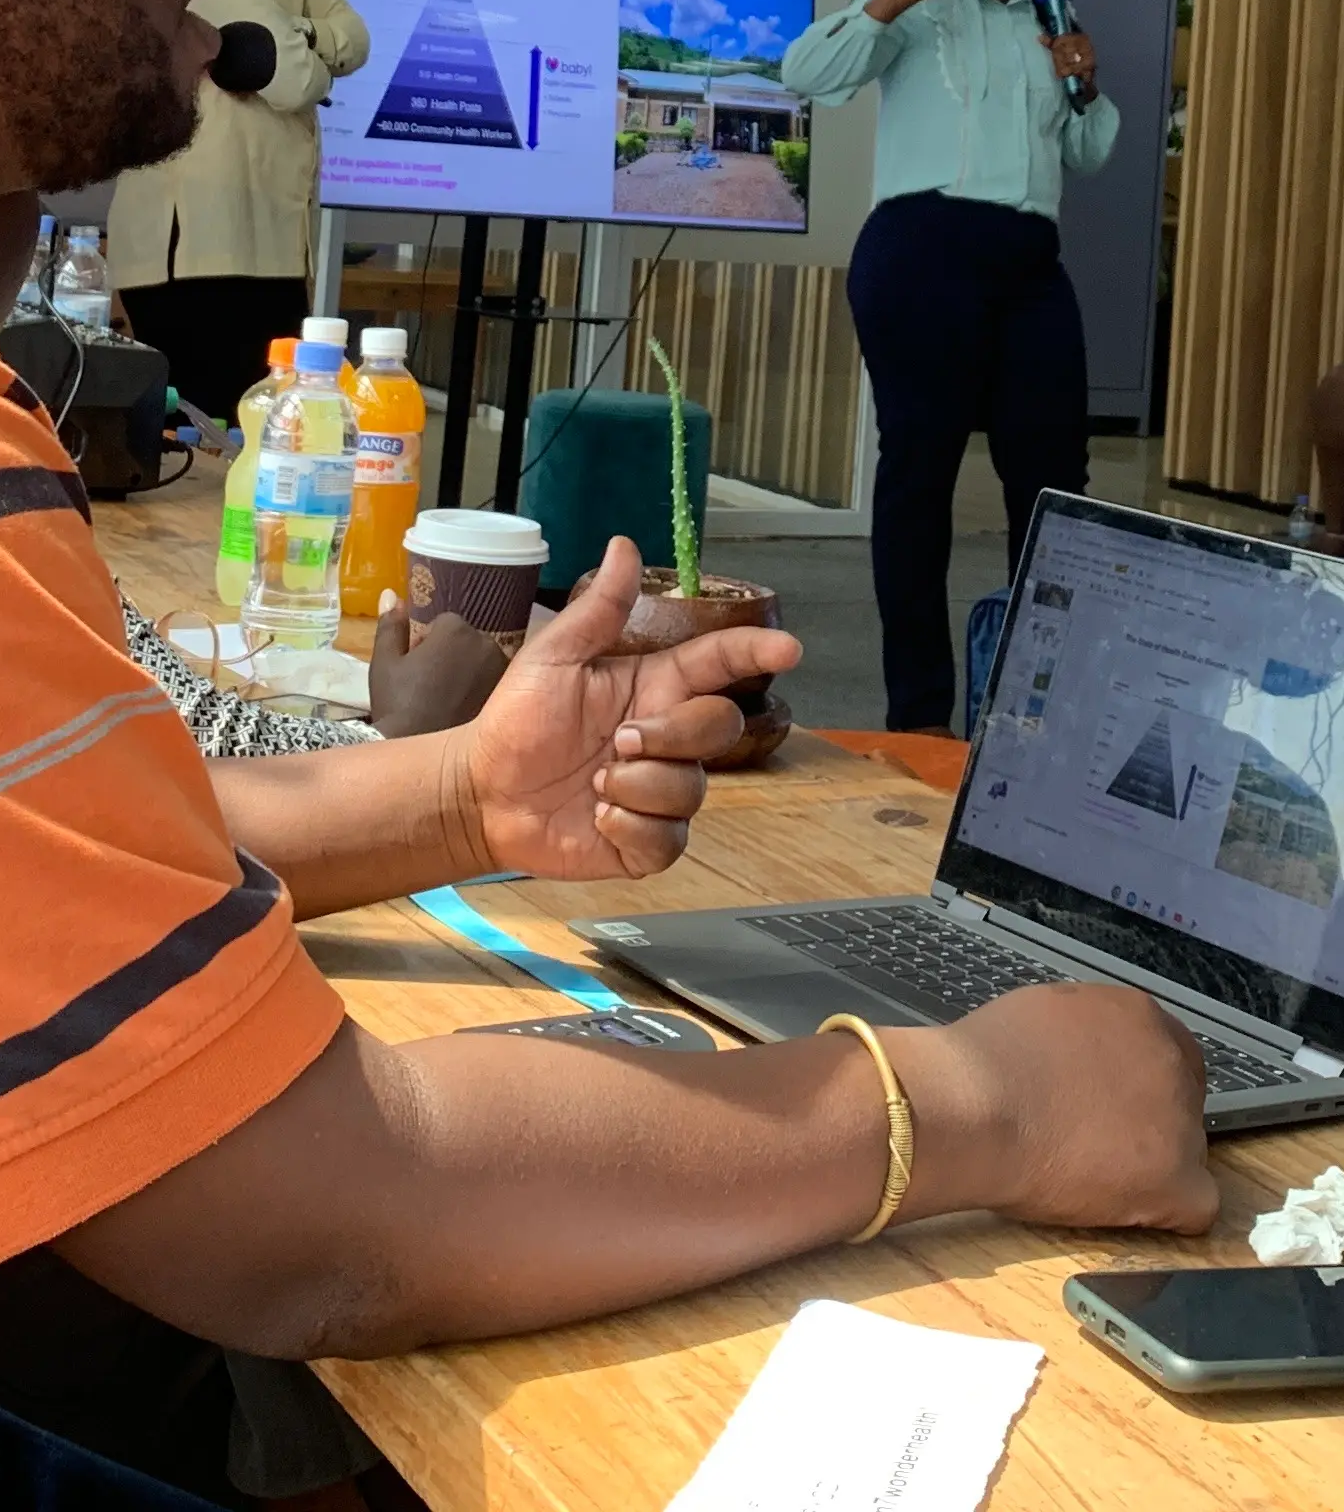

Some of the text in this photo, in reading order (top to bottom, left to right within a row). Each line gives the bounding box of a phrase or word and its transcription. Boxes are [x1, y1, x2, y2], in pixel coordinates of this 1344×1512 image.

[431, 98, 458, 111] Health
[459, 101, 482, 113] Posts
[410, 122, 454, 138] Community
[455, 126, 481, 138] Health
[481, 127, 513, 141] Workers
[359, 436, 401, 454] ANGE
[357, 459, 395, 472] ango
